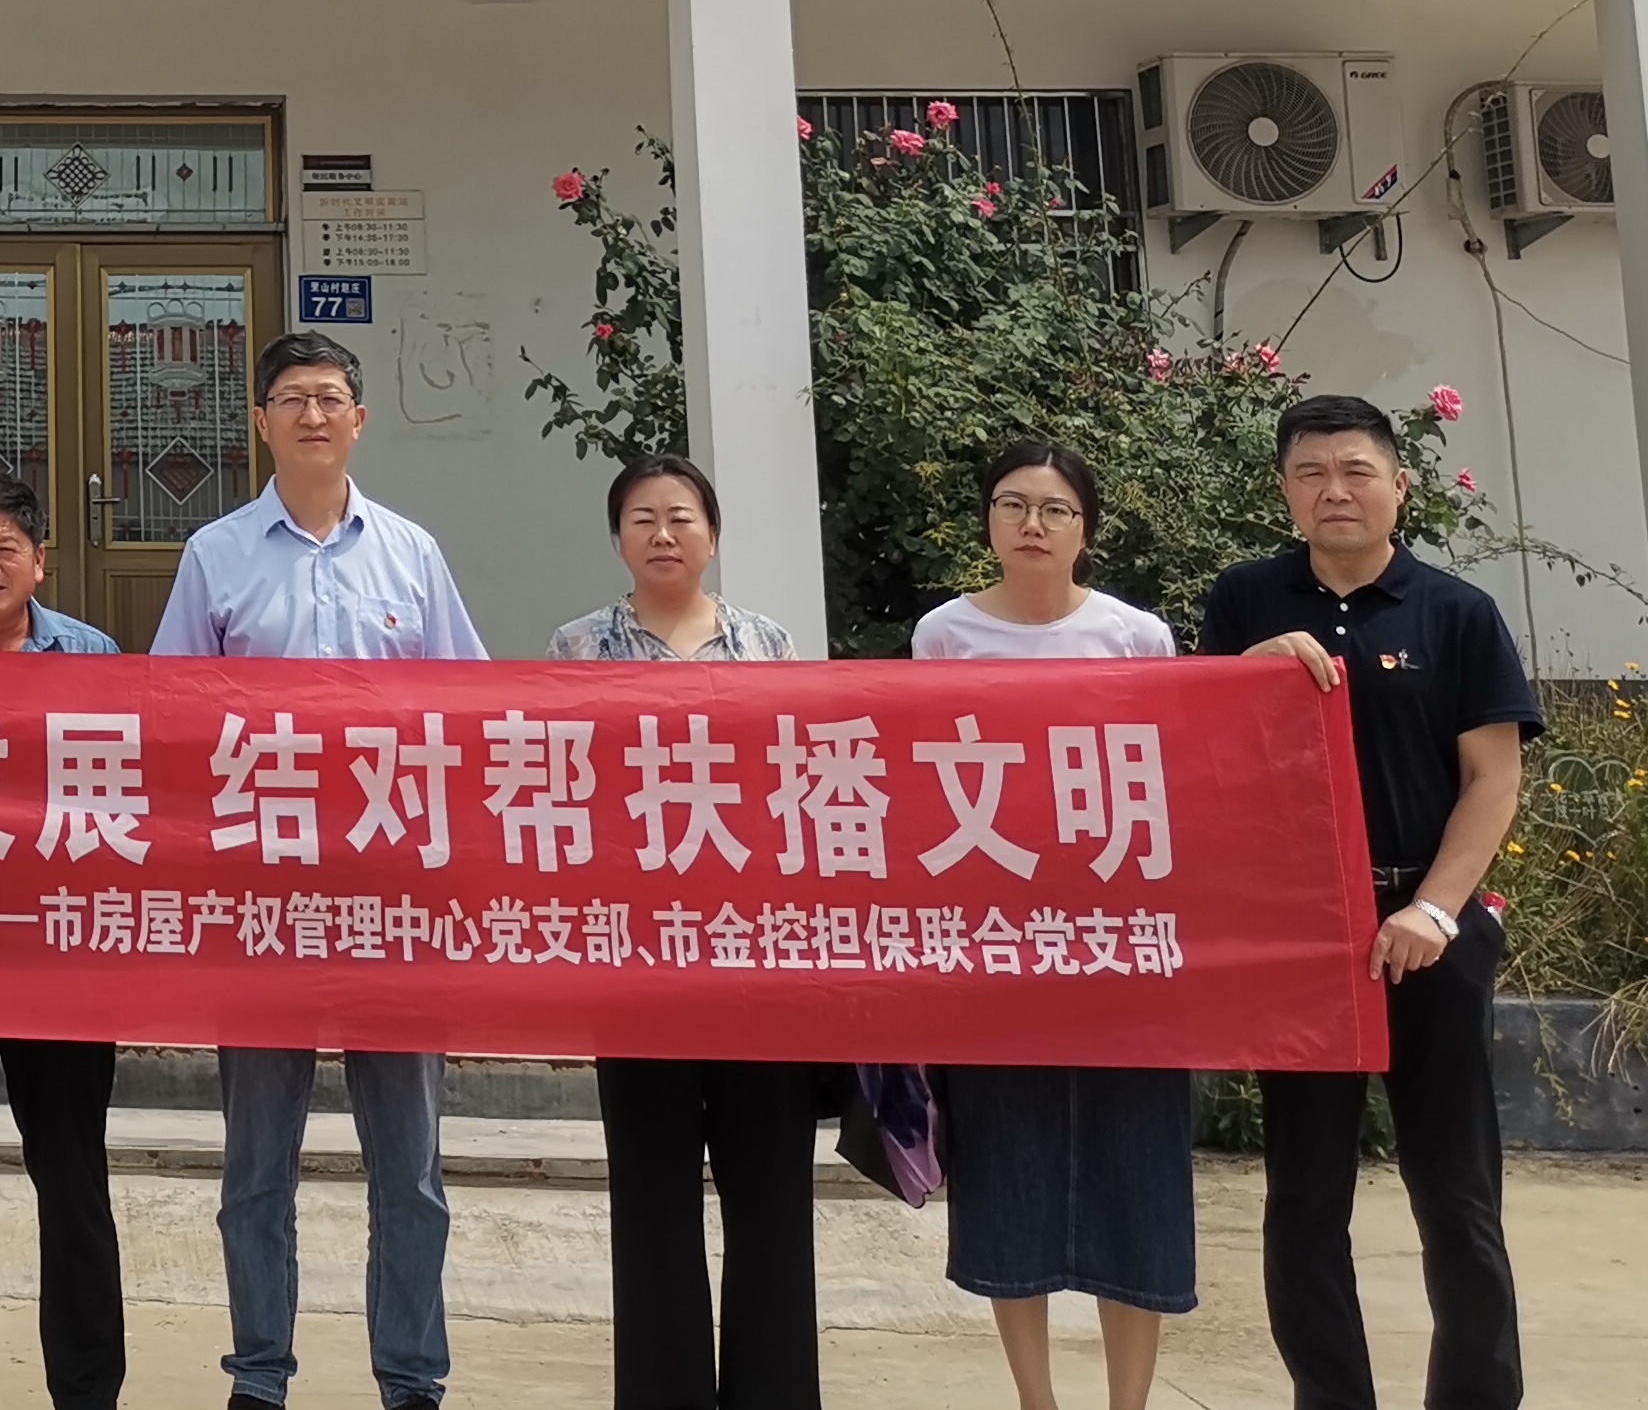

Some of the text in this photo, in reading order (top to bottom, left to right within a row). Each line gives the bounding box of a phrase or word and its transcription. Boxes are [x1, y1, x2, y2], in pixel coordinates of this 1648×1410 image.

[311, 296, 343, 317] 77
[209, 709, 1176, 884] 结对帮扶播文明
